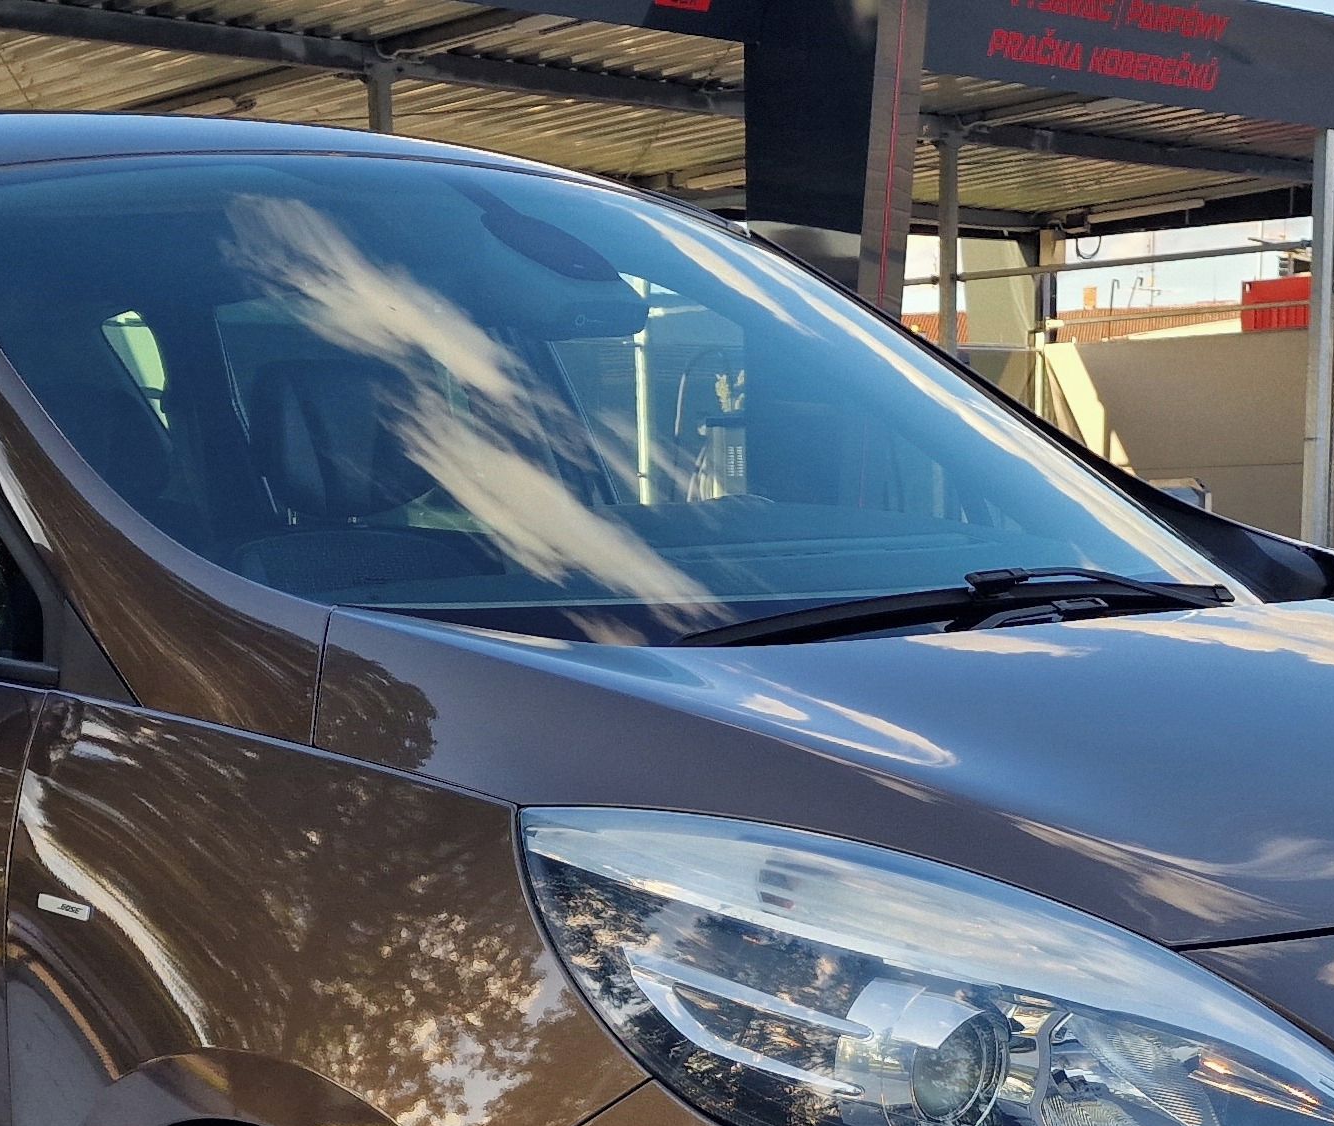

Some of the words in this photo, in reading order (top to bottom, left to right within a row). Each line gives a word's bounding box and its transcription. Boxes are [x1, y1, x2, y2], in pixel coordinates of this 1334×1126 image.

[1126, 0, 1231, 41] PARFÉMY
[987, 28, 1084, 71] PRAČKA
[1087, 46, 1221, 91] KOBEREČKŮ
